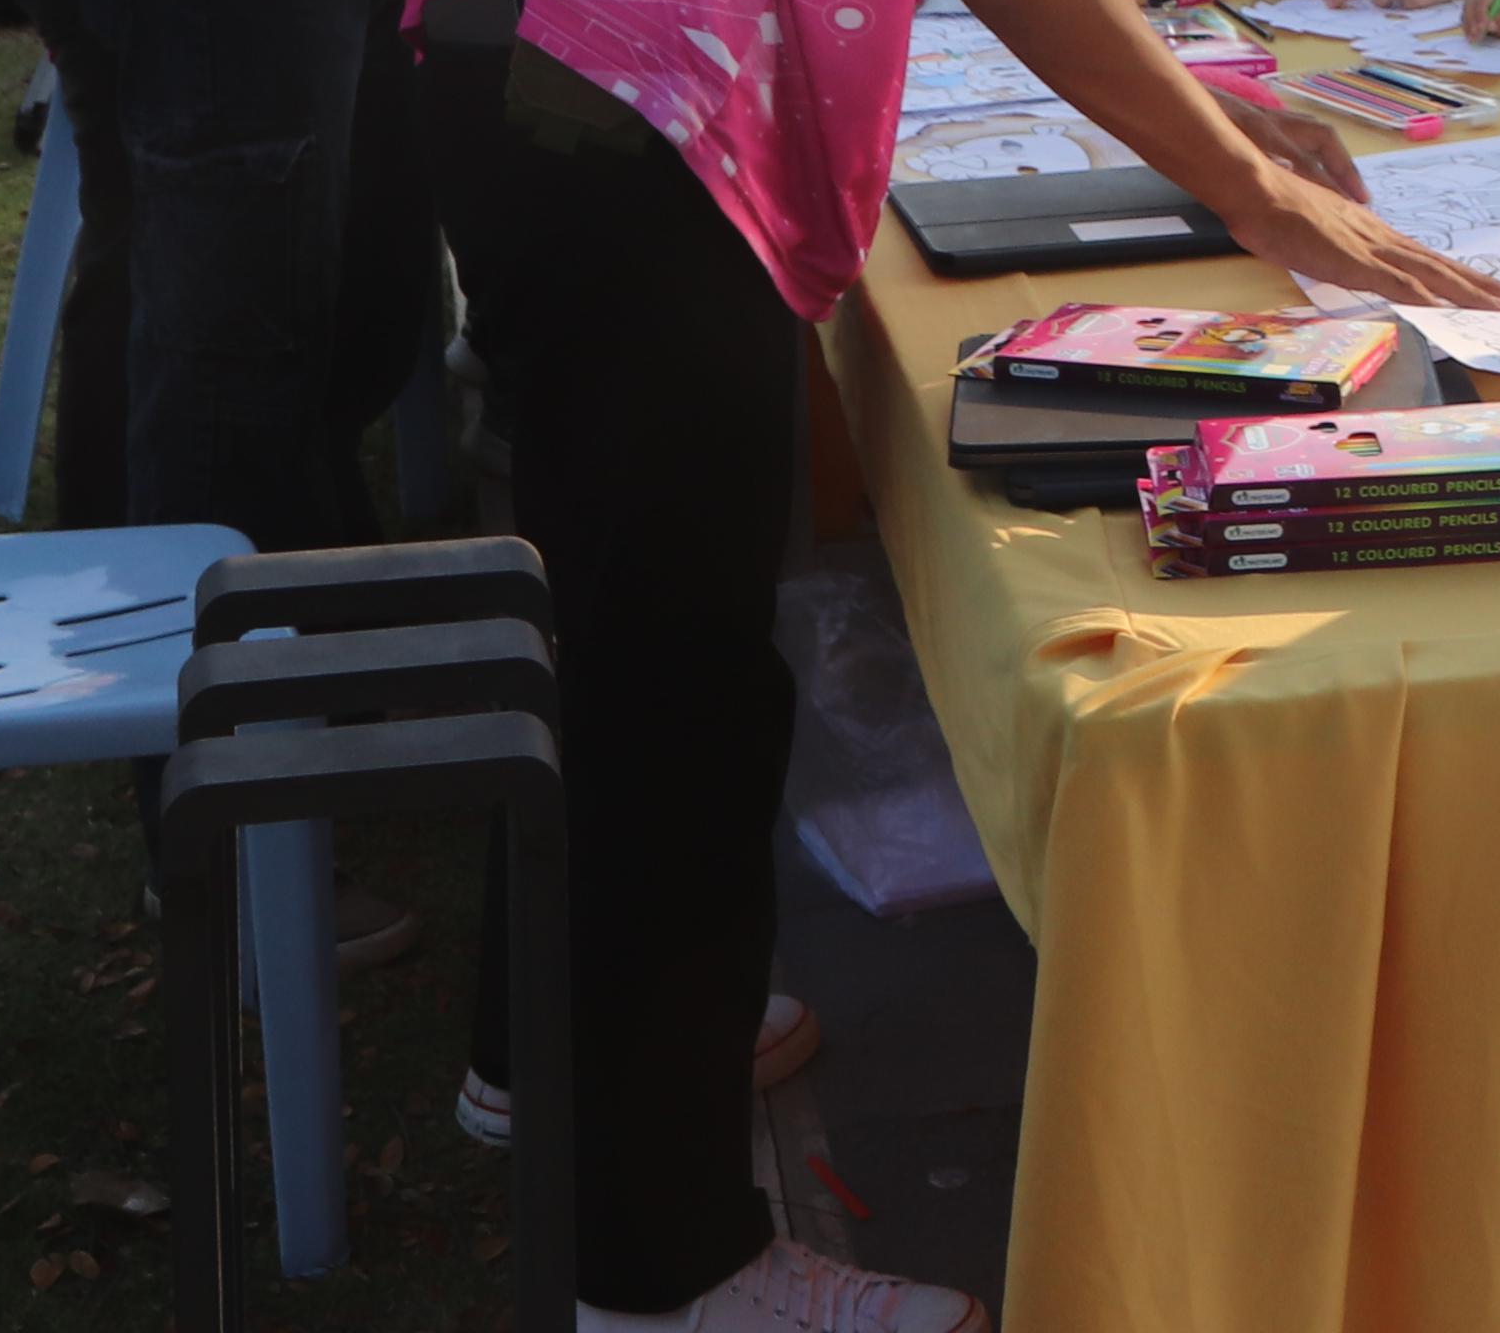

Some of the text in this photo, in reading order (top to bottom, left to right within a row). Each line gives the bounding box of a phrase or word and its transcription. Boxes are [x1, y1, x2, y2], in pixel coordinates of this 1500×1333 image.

[1334, 487, 1351, 499] 12
[1358, 482, 1439, 498] COLOURED
[1328, 512, 1499, 533] 12 COLOURED PENCILS
[1332, 551, 1349, 563] 12
[1356, 546, 1437, 562] COLOURED
